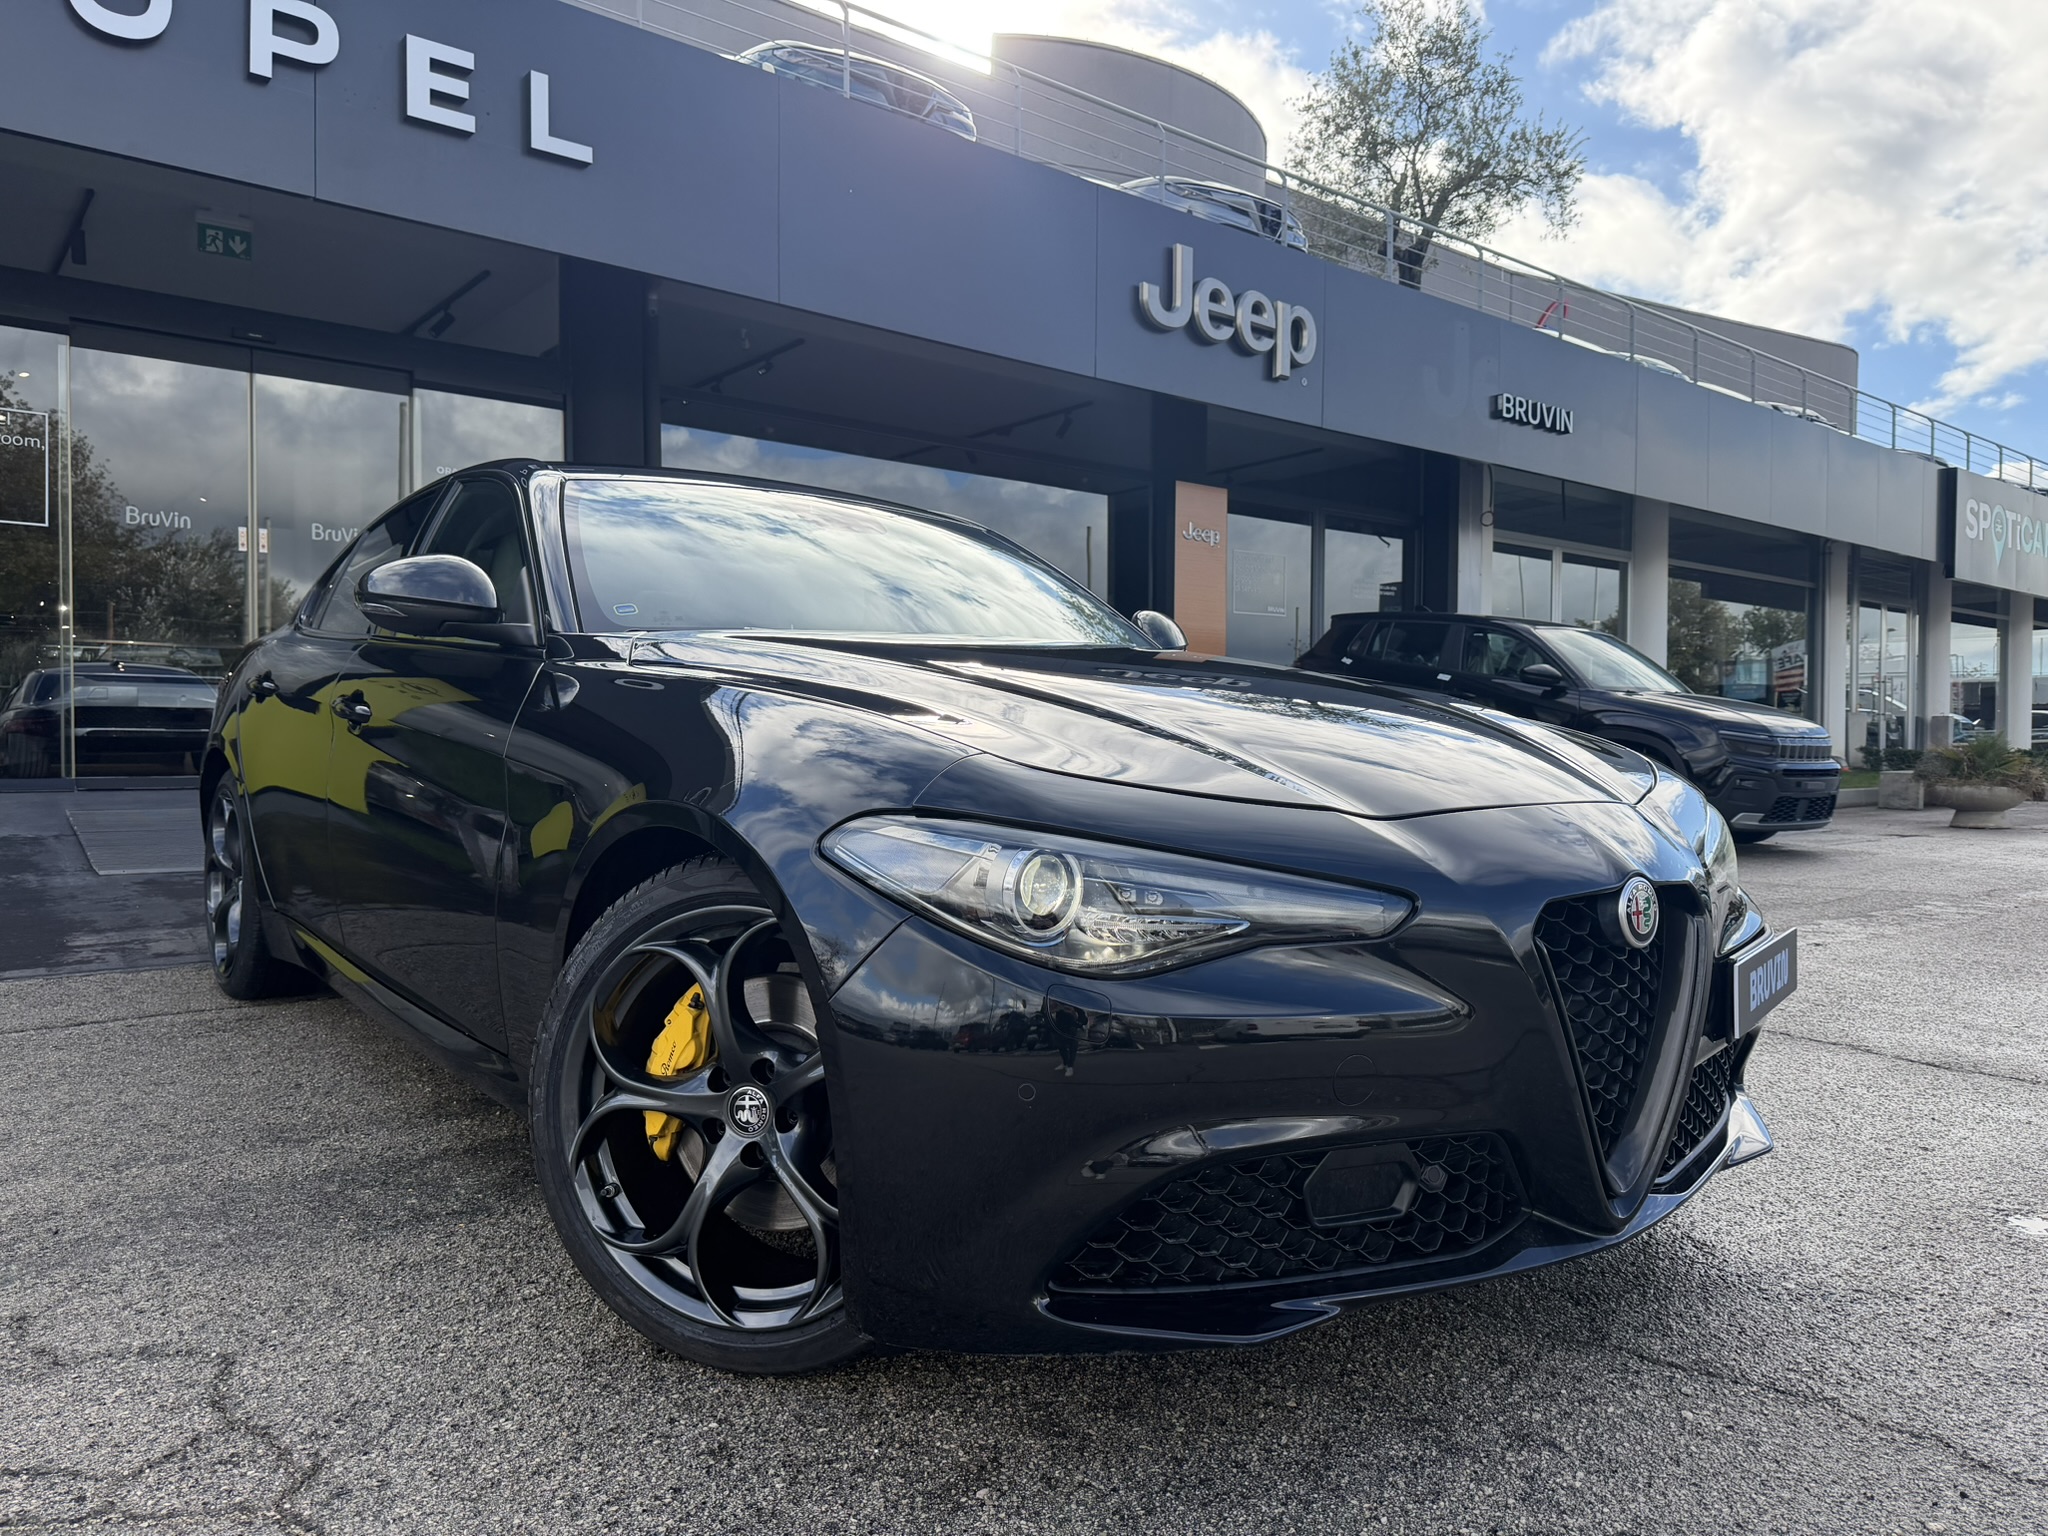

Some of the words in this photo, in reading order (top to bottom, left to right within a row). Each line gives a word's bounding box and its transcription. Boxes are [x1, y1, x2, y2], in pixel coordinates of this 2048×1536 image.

[1139, 243, 1317, 380] Jeep
[1499, 392, 1574, 433] BRUVIN
[0, 434, 45, 451] oom,
[125, 505, 191, 529] BruVin
[311, 522, 358, 543] BruVi
[1182, 521, 1220, 547] Jeep
[1965, 498, 2048, 569] SPOTiCA
[1750, 948, 1789, 1012] BRUVIN
[747, 1089, 764, 1105] ALFA
[747, 1107, 767, 1132] ROMEO
